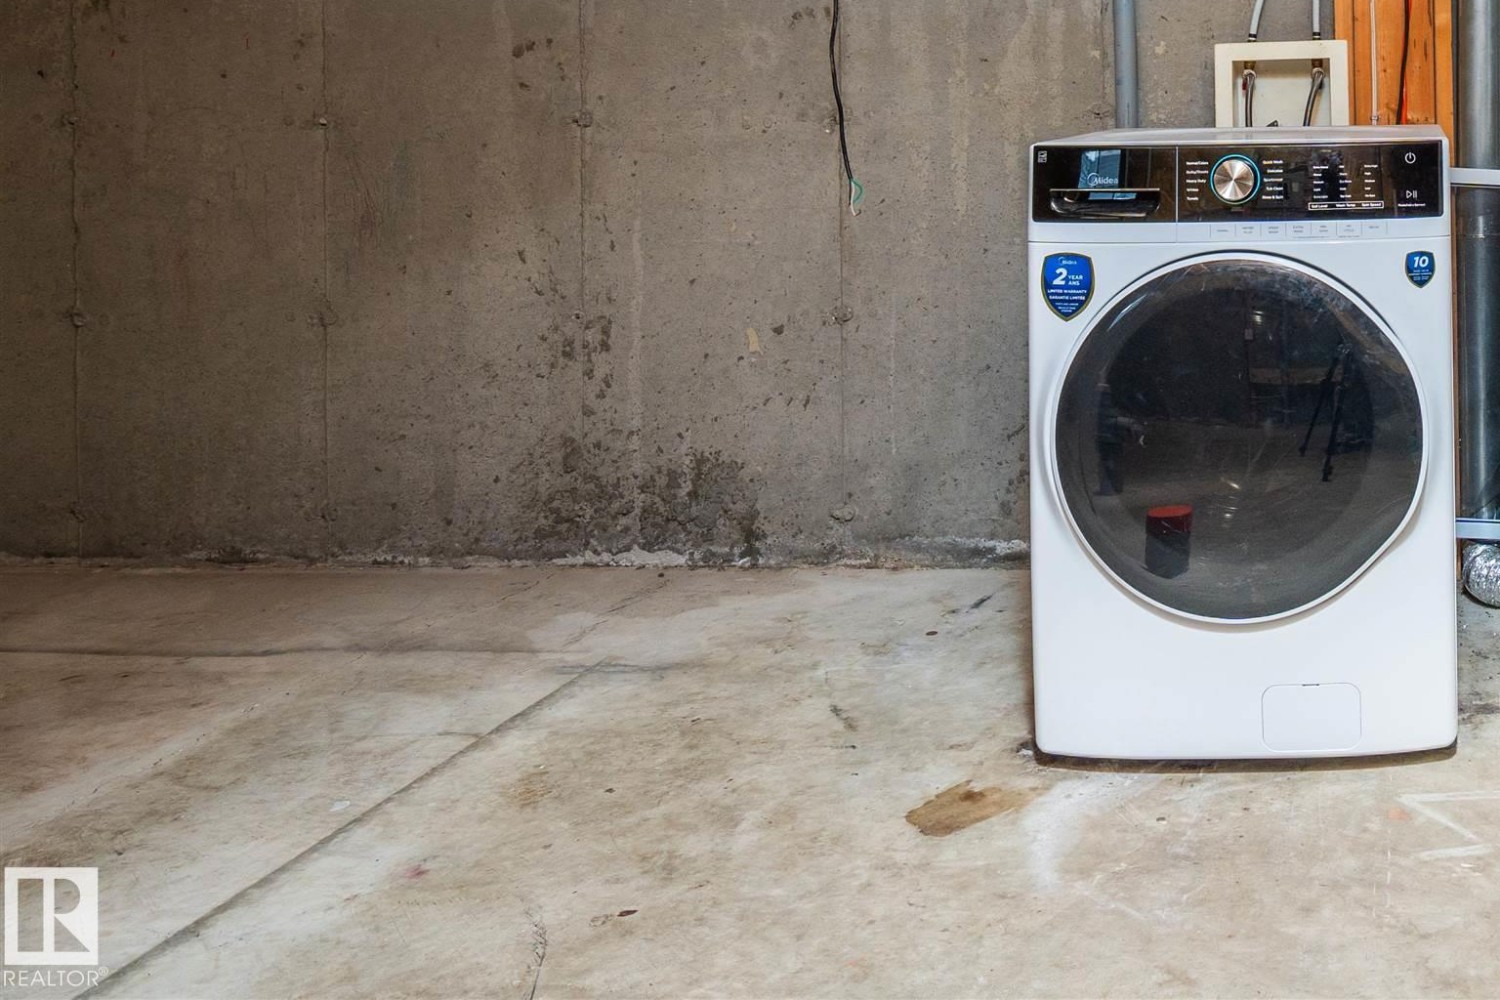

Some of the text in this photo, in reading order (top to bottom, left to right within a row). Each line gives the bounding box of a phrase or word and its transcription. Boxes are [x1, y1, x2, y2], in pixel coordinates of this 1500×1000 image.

[1090, 174, 1118, 186] Midea
[1413, 256, 1429, 268] 10
[1053, 267, 1068, 285] 2
